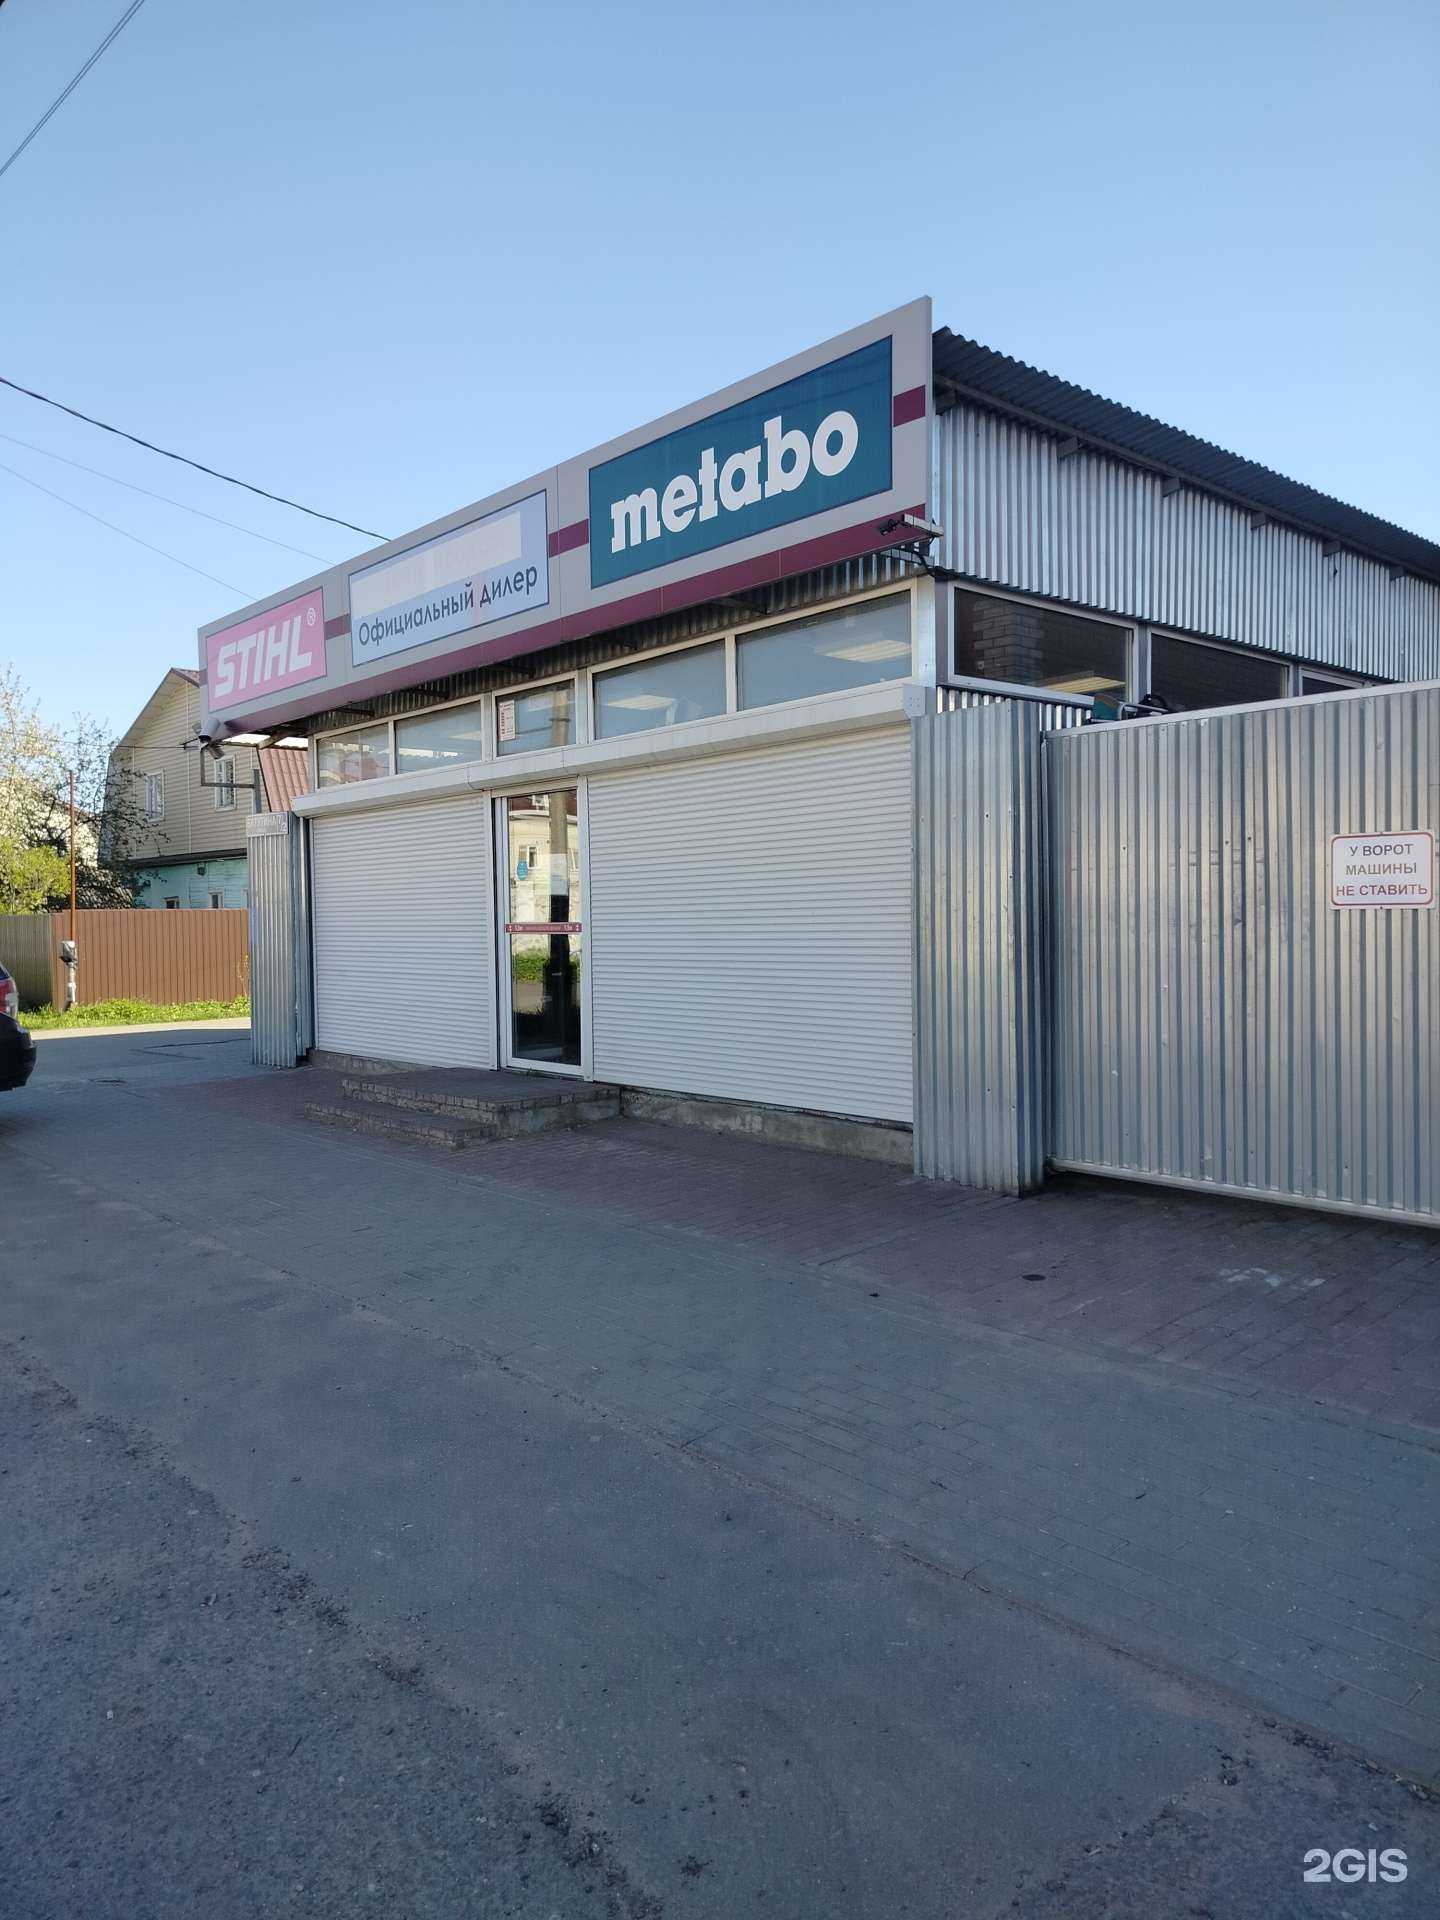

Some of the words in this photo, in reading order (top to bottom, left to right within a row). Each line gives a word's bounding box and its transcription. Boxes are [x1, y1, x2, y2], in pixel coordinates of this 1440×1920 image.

[611, 410, 859, 553] metabo
[359, 582, 474, 646] Официальный
[480, 565, 537, 607] дилер
[1349, 846, 1359, 857] У
[1362, 843, 1414, 857] ВОРОТ
[1345, 862, 1417, 876] МАШИНЫ
[1336, 885, 1355, 897] НЕ
[1359, 883, 1428, 896] СТАВИТЬ
